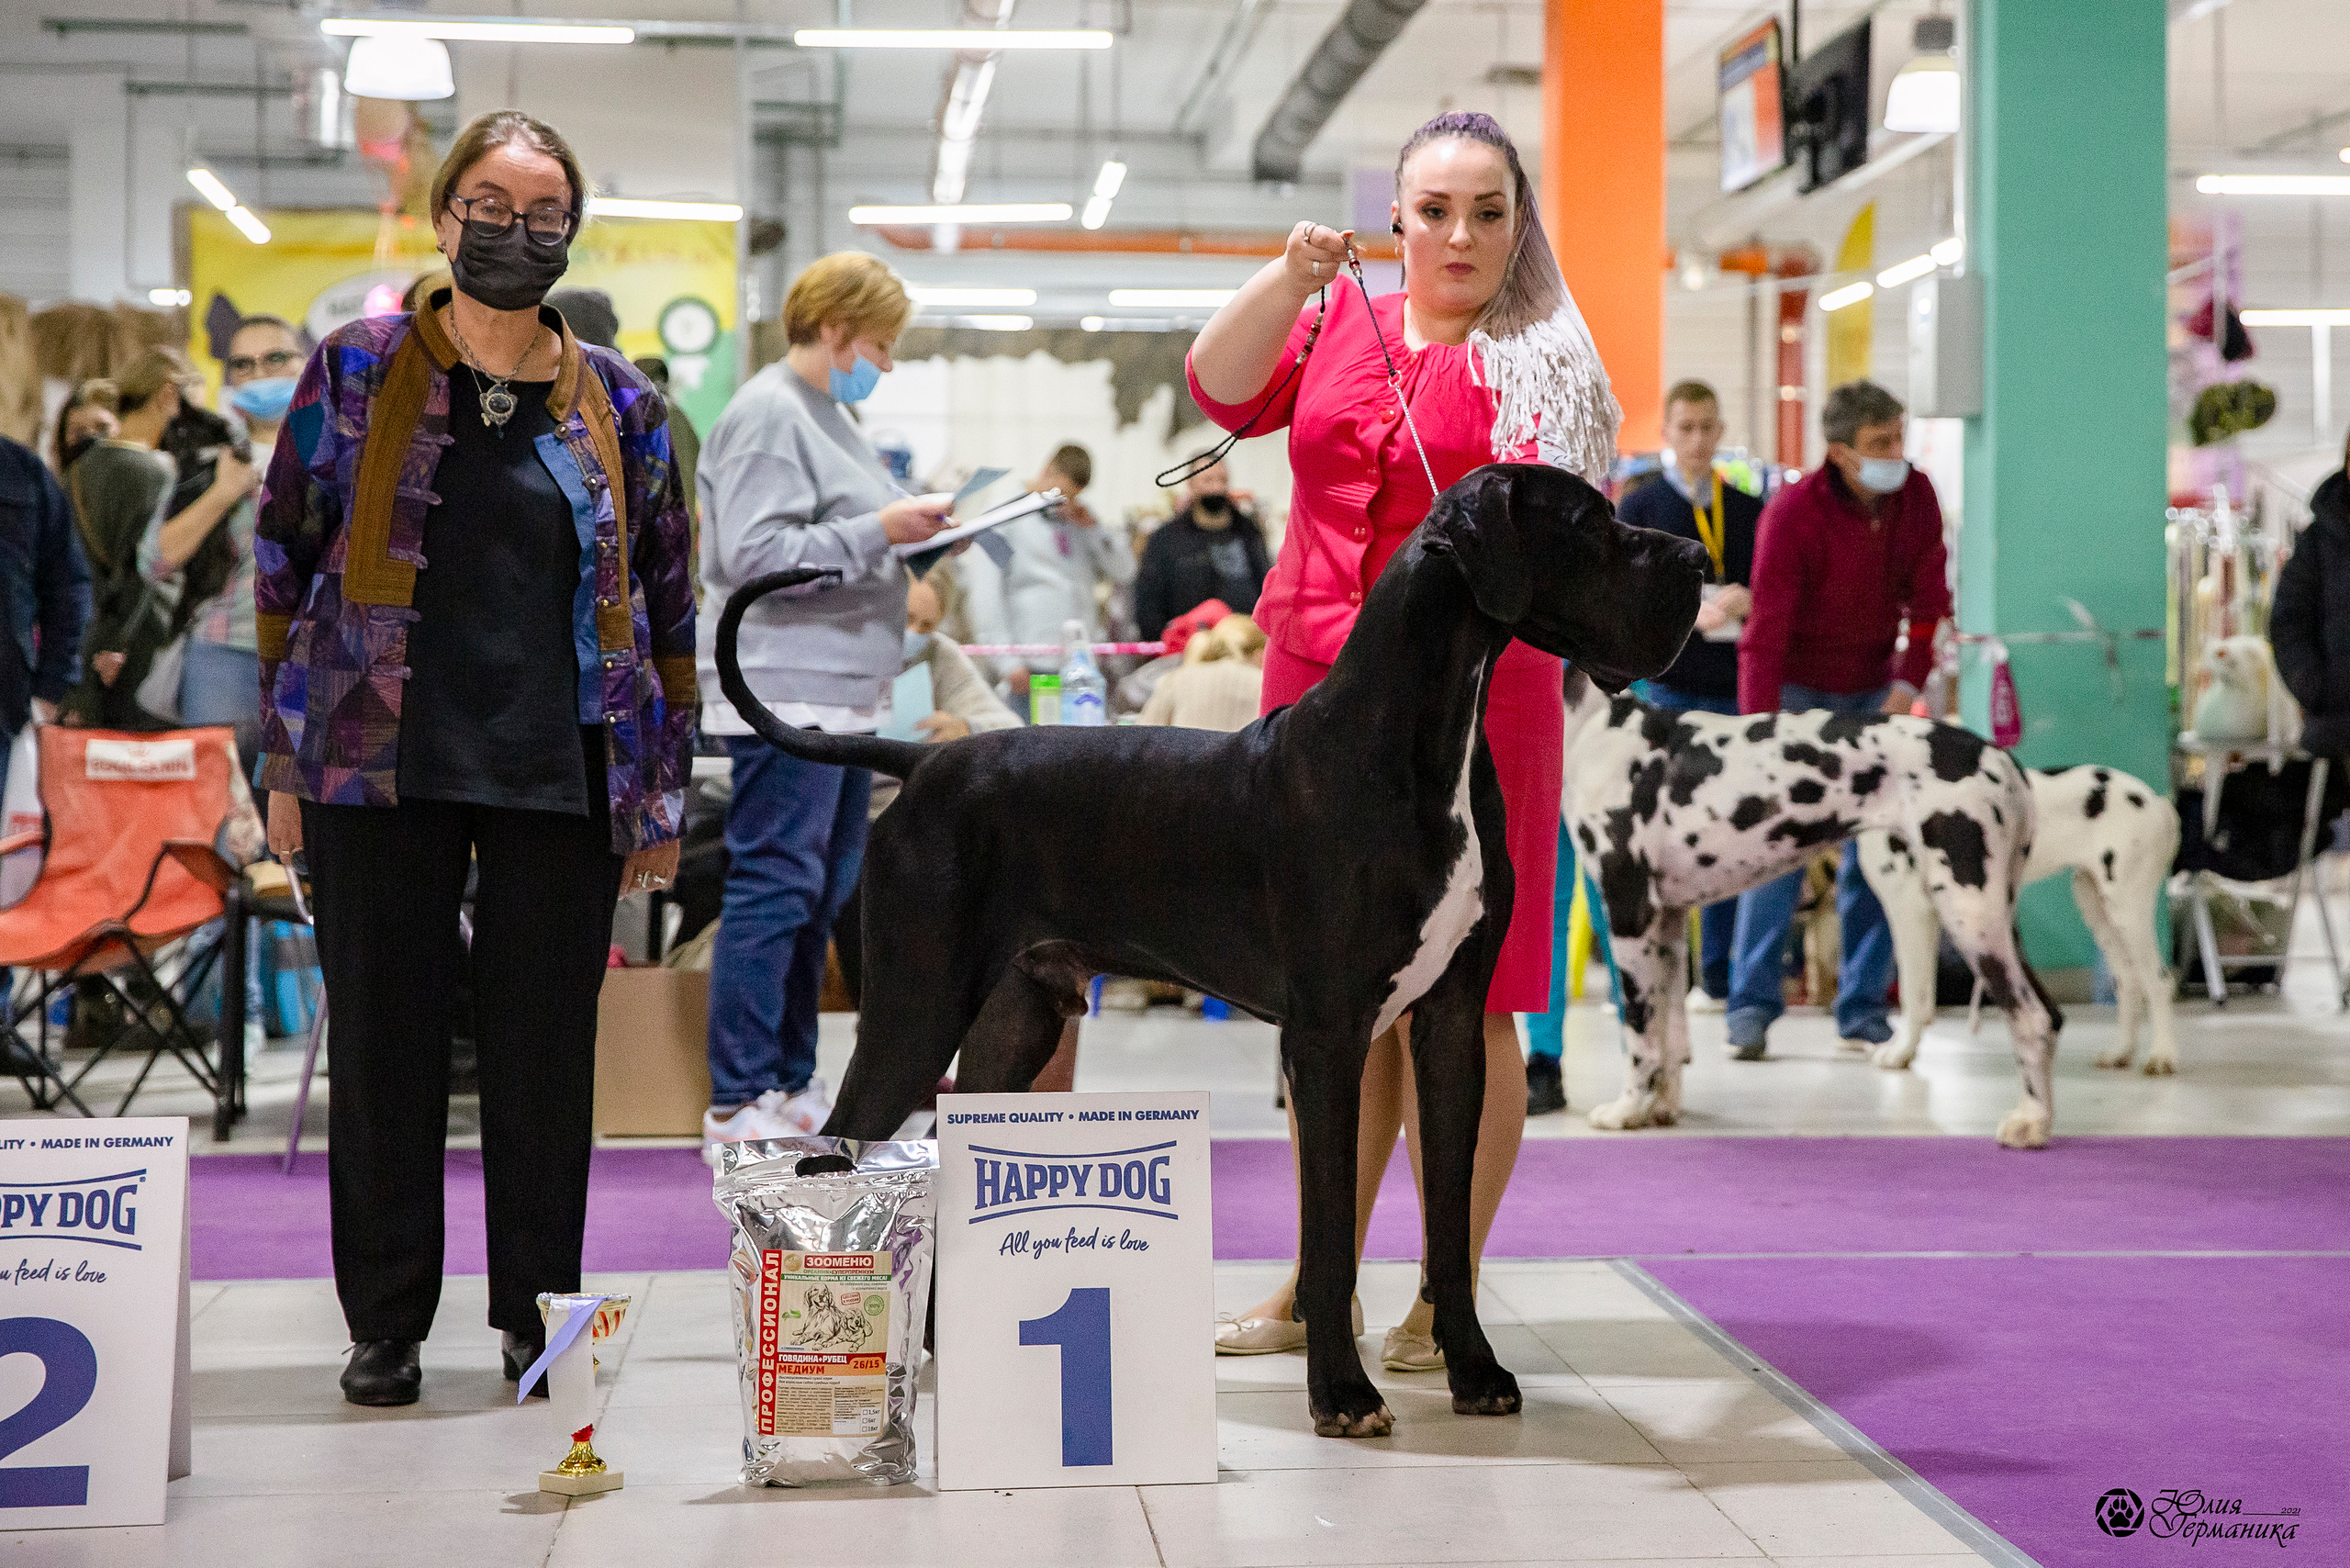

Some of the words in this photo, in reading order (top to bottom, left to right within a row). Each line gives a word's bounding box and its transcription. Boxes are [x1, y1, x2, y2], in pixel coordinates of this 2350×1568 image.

[946, 1113, 1006, 1125] SUPREME
[1008, 1112, 1065, 1124] QUALITY
[1078, 1110, 1115, 1121] MADE
[1117, 1110, 1132, 1121] IN
[1135, 1109, 1200, 1121] GERMANY
[40, 1137, 81, 1149] MADE
[84, 1137, 100, 1148] IN
[103, 1136, 174, 1148] GERMANY
[974, 1157, 1093, 1211] HAPPY
[1098, 1155, 1171, 1205] DOG
[56, 1183, 138, 1236] DOG
[999, 1229, 1030, 1257] All
[1033, 1238, 1063, 1260] you
[1064, 1226, 1100, 1253] feed
[1102, 1235, 1116, 1249] is
[1119, 1228, 1149, 1251] love
[15, 1258, 54, 1285] feed
[55, 1267, 72, 1281] is
[75, 1260, 108, 1283] love
[806, 1257, 873, 1267] ЗООМЕНЮ
[761, 1252, 779, 1432] ПРОФЕССИОНАЛ
[778, 1364, 825, 1375] МЕДИУМ
[853, 1359, 880, 1370] 26/15
[1018, 1287, 1113, 1467] 1
[0, 1316, 97, 1508] 2
